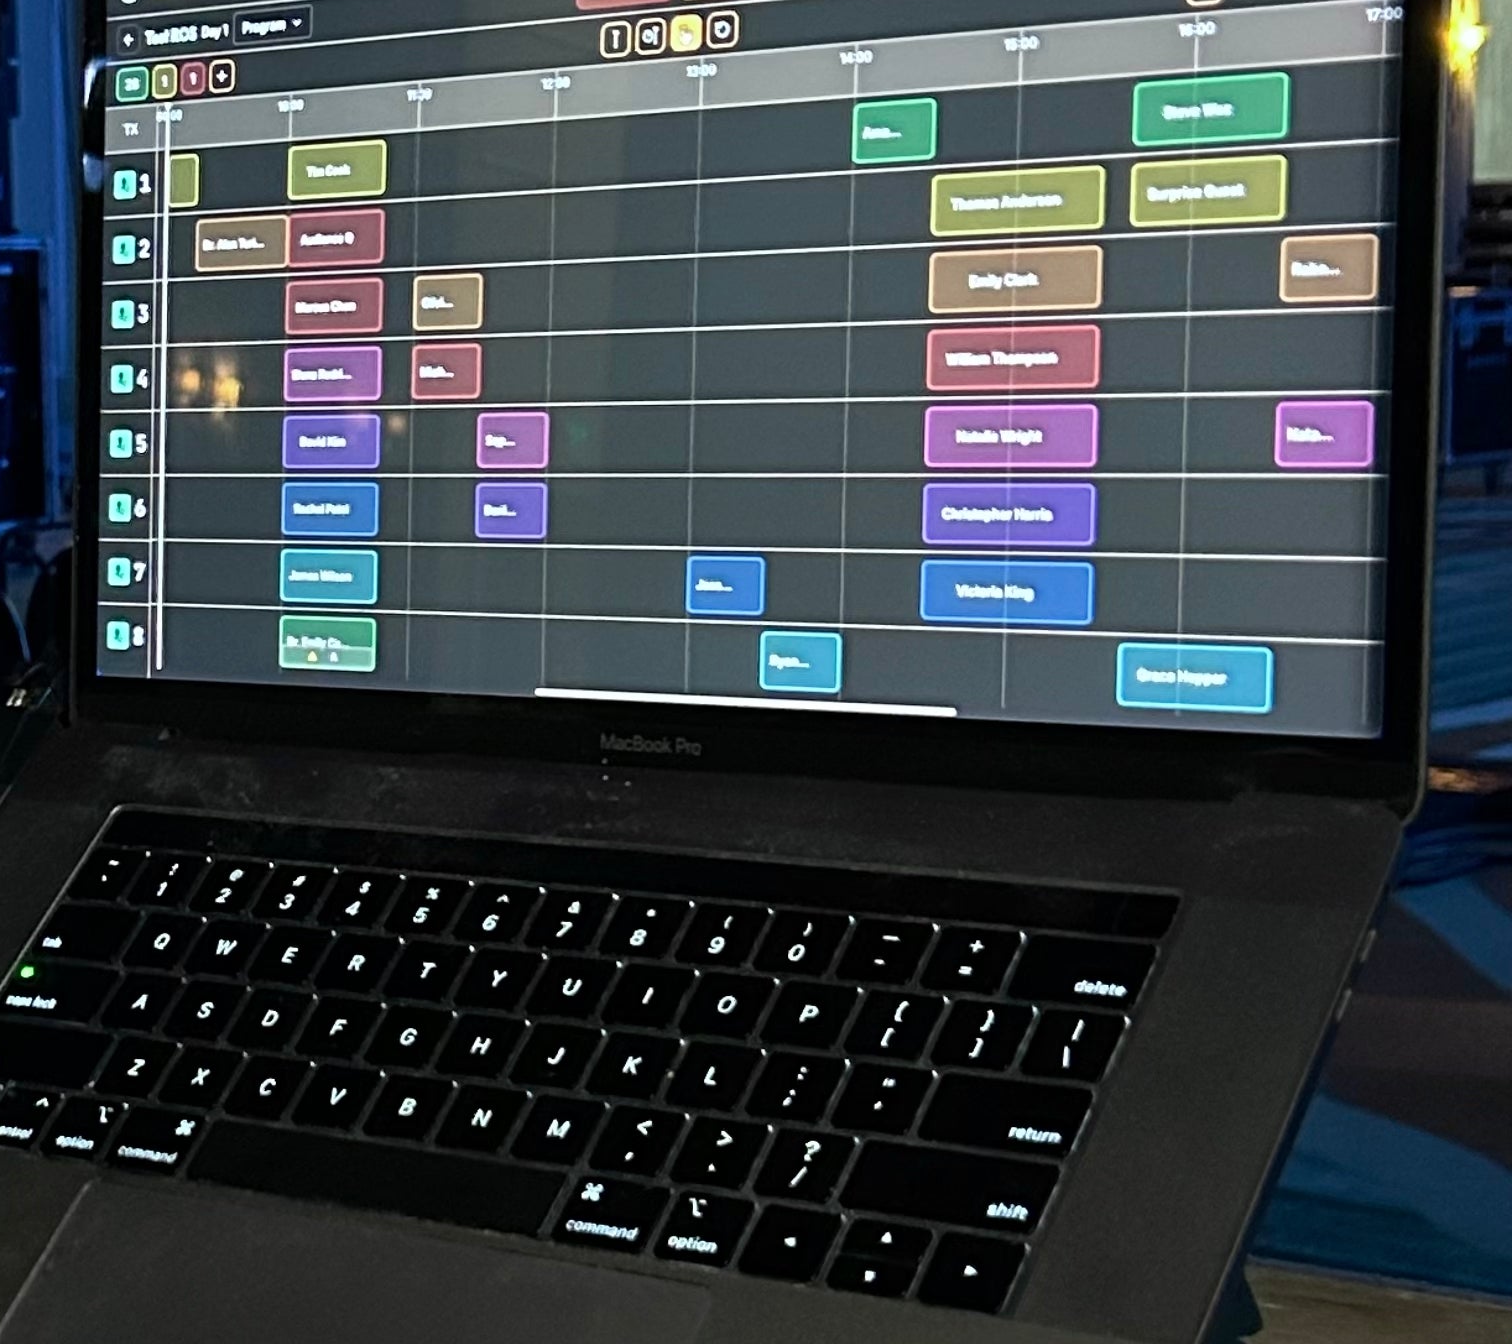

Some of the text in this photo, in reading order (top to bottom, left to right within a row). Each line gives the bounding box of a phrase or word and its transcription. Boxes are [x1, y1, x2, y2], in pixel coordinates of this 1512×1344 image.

[1365, 6, 1403, 23] 17:00
[201, 24, 221, 42] Day
[241, 18, 288, 37] Program
[122, 122, 139, 136] TX
[139, 173, 152, 194] 1
[138, 237, 151, 258] 2
[137, 303, 150, 324] 3
[136, 369, 149, 389] 4
[135, 434, 147, 454] 5
[134, 499, 146, 519] 6
[133, 562, 147, 583] 7
[1004, 583, 1035, 603] King
[132, 625, 146, 646] 8
[600, 732, 702, 756] MacBook Pro
[156, 881, 1127, 997] 1 2 3 4 5 6 7 8 9 0 delete
[153, 932, 171, 950] Q
[215, 938, 238, 956] W
[281, 946, 299, 964] E
[347, 954, 366, 972] R
[420, 961, 437, 979] T
[491, 969, 508, 987] Y
[562, 977, 583, 996] U
[717, 995, 737, 1014] O
[798, 1004, 820, 1023] P
[131, 993, 149, 1010] A
[196, 1001, 215, 1019] S
[261, 1009, 280, 1027] D
[329, 1018, 348, 1036] F
[399, 1027, 418, 1046] G
[470, 1036, 492, 1055] H
[547, 1047, 566, 1065] J
[622, 1055, 643, 1075] K
[703, 1065, 717, 1086] L
[1007, 1126, 1062, 1144] return
[126, 1058, 146, 1077] Z
[190, 1067, 211, 1086] X
[259, 1077, 277, 1096] C
[329, 1087, 347, 1106] V
[398, 1097, 417, 1116] B
[471, 1108, 493, 1128] N
[546, 1118, 571, 1139] M
[986, 1202, 1029, 1221] shift
[55, 1135, 95, 1151] option
[117, 1145, 178, 1164] command
[565, 1219, 639, 1241] command
[667, 1235, 718, 1254] option
